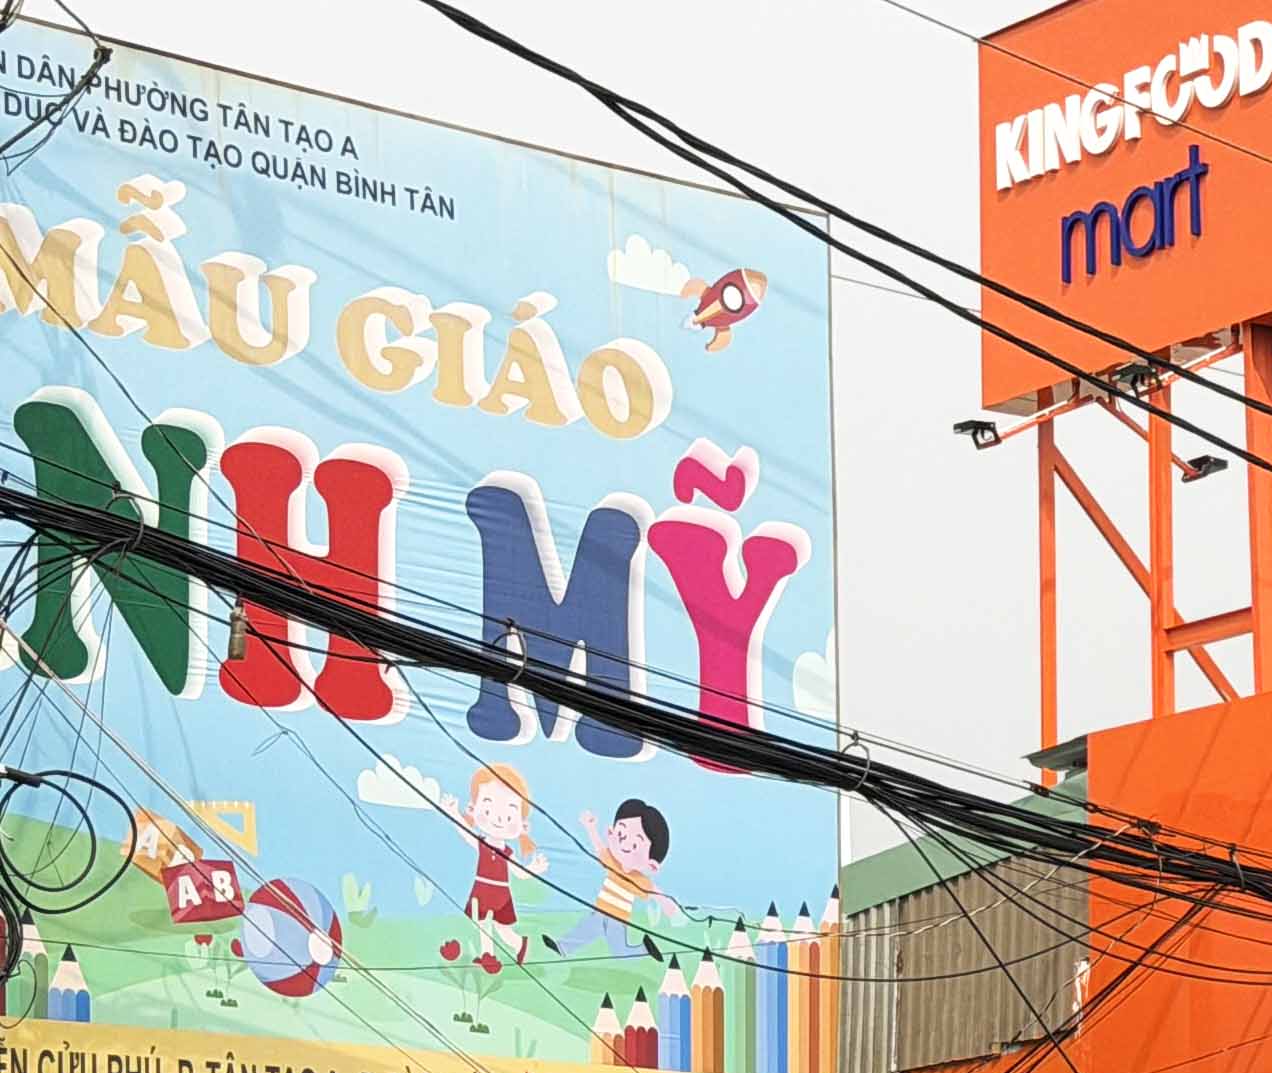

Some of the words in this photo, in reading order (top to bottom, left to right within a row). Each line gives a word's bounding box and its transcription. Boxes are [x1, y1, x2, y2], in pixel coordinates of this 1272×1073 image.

[17, 54, 75, 90] DÂN
[217, 102, 271, 138] TÂN
[279, 119, 333, 153] TẠO
[341, 136, 359, 161] A
[72, 106, 110, 139] VÀ
[119, 117, 179, 154] ĐÀO
[186, 134, 243, 169] TẠO
[251, 150, 326, 190] QUẬN
[336, 167, 397, 207] BÌNH
[404, 185, 455, 220] TÂN
[1061, 144, 1209, 285] mart
[336, 291, 672, 439] GIÁO
